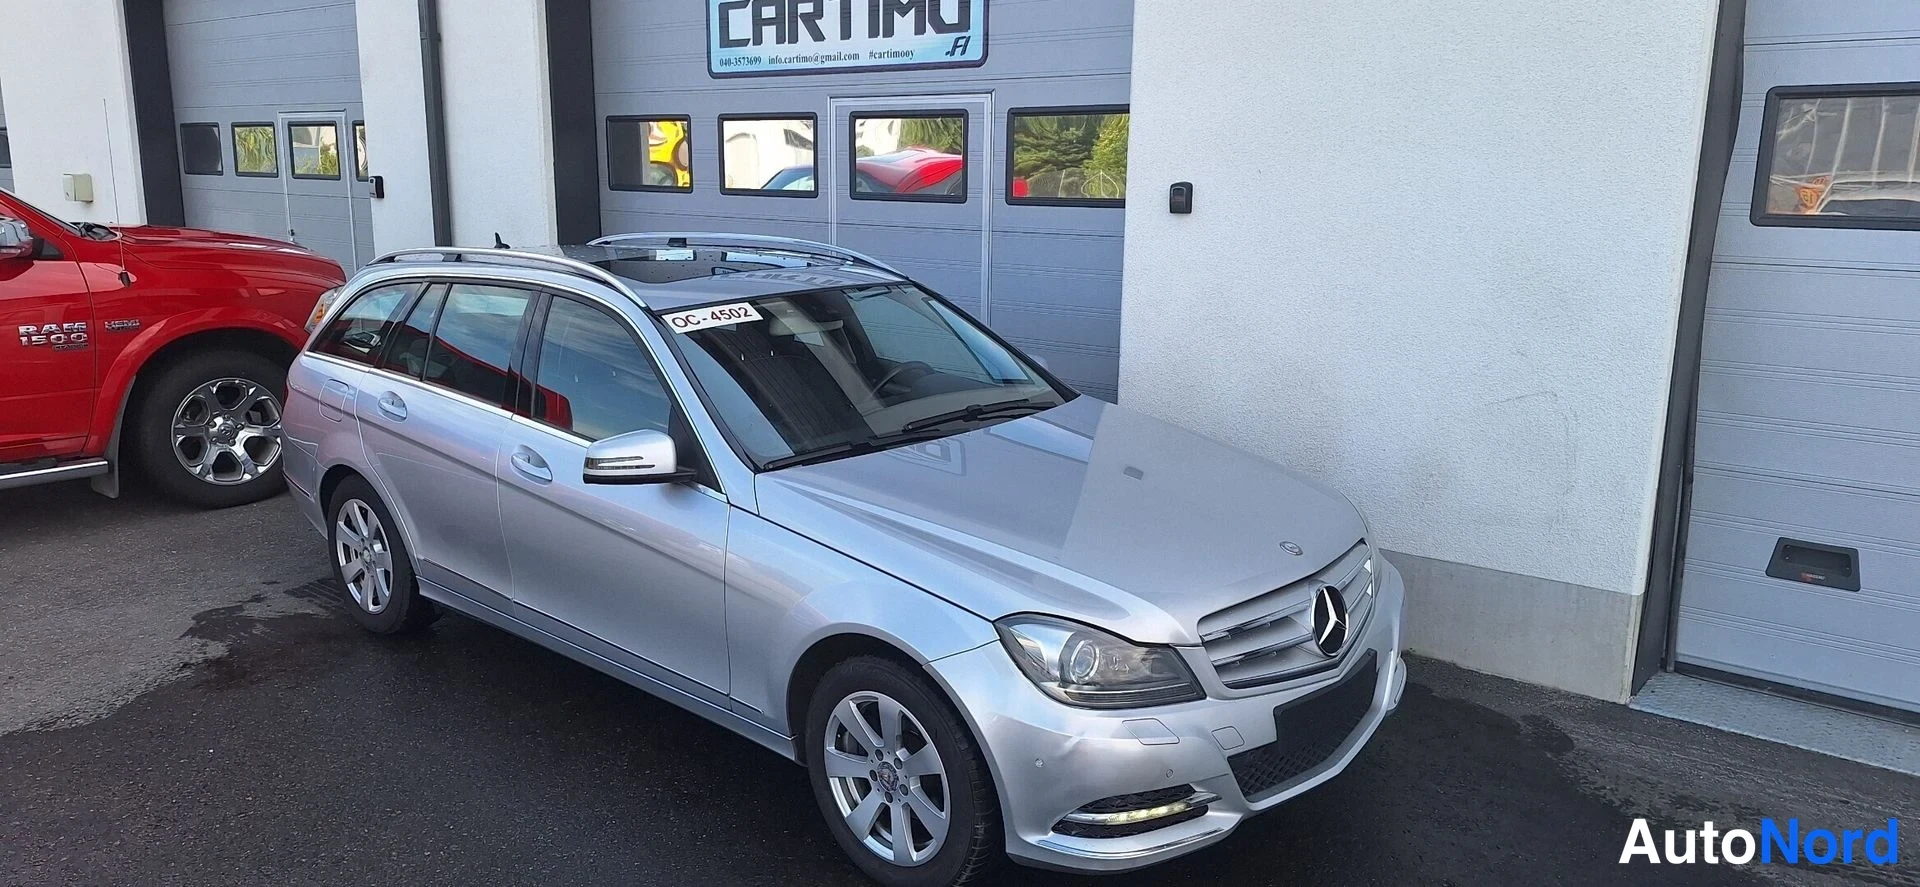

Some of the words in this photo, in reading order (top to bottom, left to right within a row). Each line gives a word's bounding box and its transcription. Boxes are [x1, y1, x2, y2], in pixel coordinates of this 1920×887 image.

[718, 0, 971, 48] CARTIMO
[719, 56, 762, 67] 040-3573699
[768, 51, 860, 65] info.cartimo@gmail.com
[868, 48, 915, 60] #cartimooy
[18, 322, 87, 335] RAM
[20, 332, 88, 346] 1500
